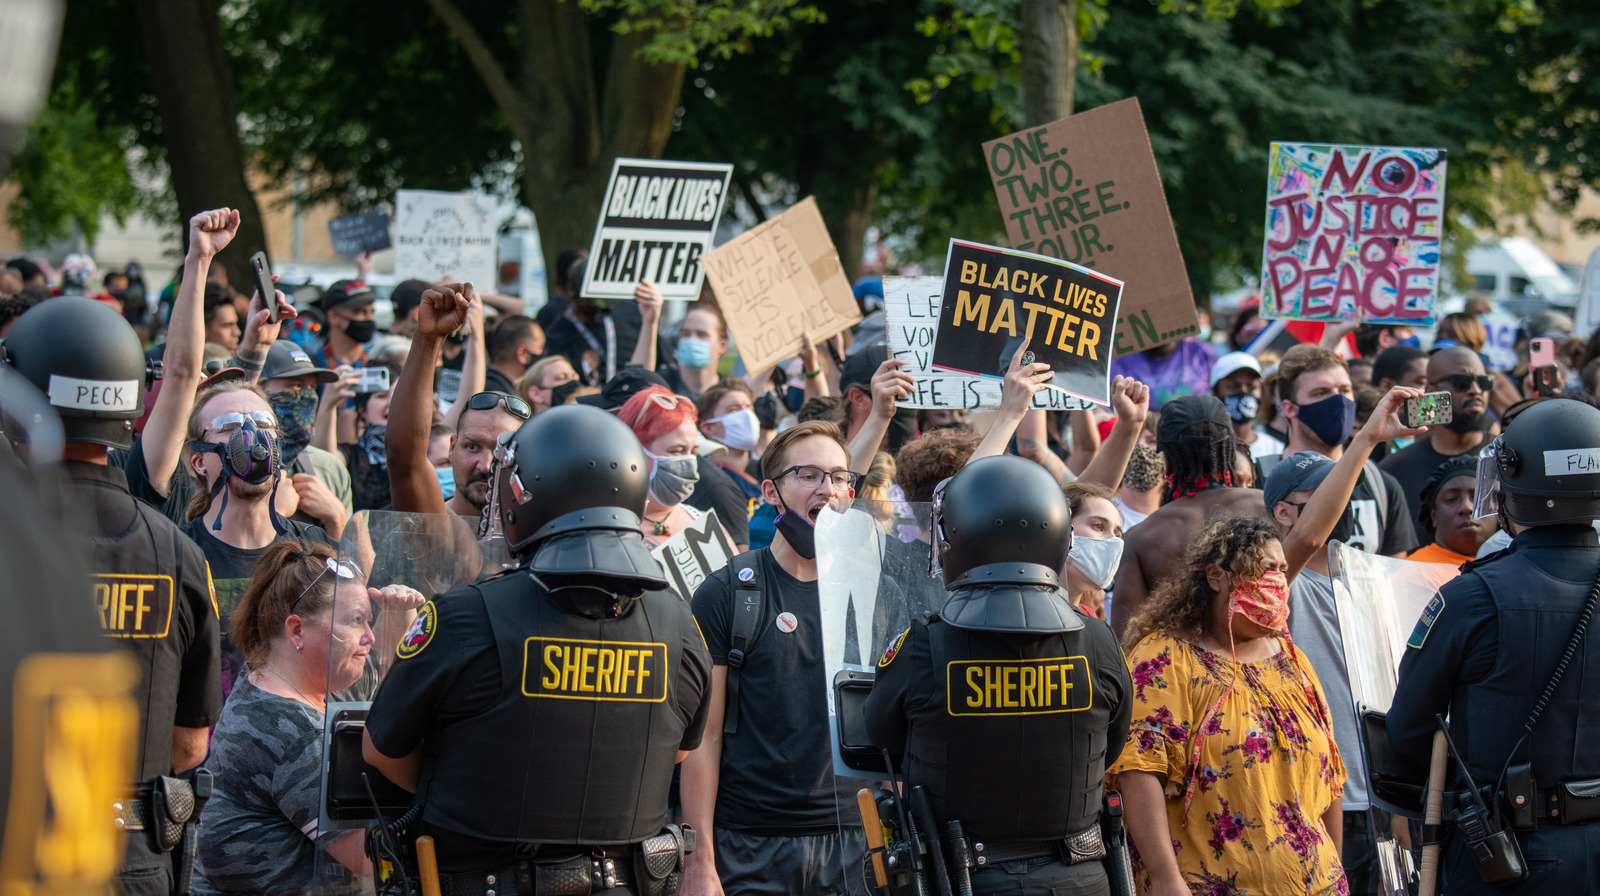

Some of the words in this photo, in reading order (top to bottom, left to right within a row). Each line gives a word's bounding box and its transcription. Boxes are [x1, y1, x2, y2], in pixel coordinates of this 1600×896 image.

[991, 128, 1068, 177] ONE.
[1321, 150, 1417, 194] NO
[607, 174, 678, 219] BLACK
[666, 178, 723, 222] LIVES
[997, 160, 1083, 208] TWO.
[1010, 181, 1130, 240] THREE.
[1267, 193, 1439, 252] JUSTICE
[592, 238, 703, 285] MATTER
[706, 220, 788, 284] WHITE
[1017, 223, 1114, 264] OUR.
[1308, 234, 1396, 270] NO
[722, 249, 802, 313] SILENCE
[959, 259, 1049, 299] BLACK
[1053, 278, 1108, 318] LIVES
[1268, 256, 1436, 319] PEACE
[741, 296, 835, 362] VIOLENCE
[746, 296, 781, 328] IS
[952, 290, 1101, 361] MATTER
[76, 386, 124, 406] PECK
[962, 380, 982, 409] IS
[542, 645, 654, 694] SHERIFF
[966, 664, 1074, 708] SHERIFF
